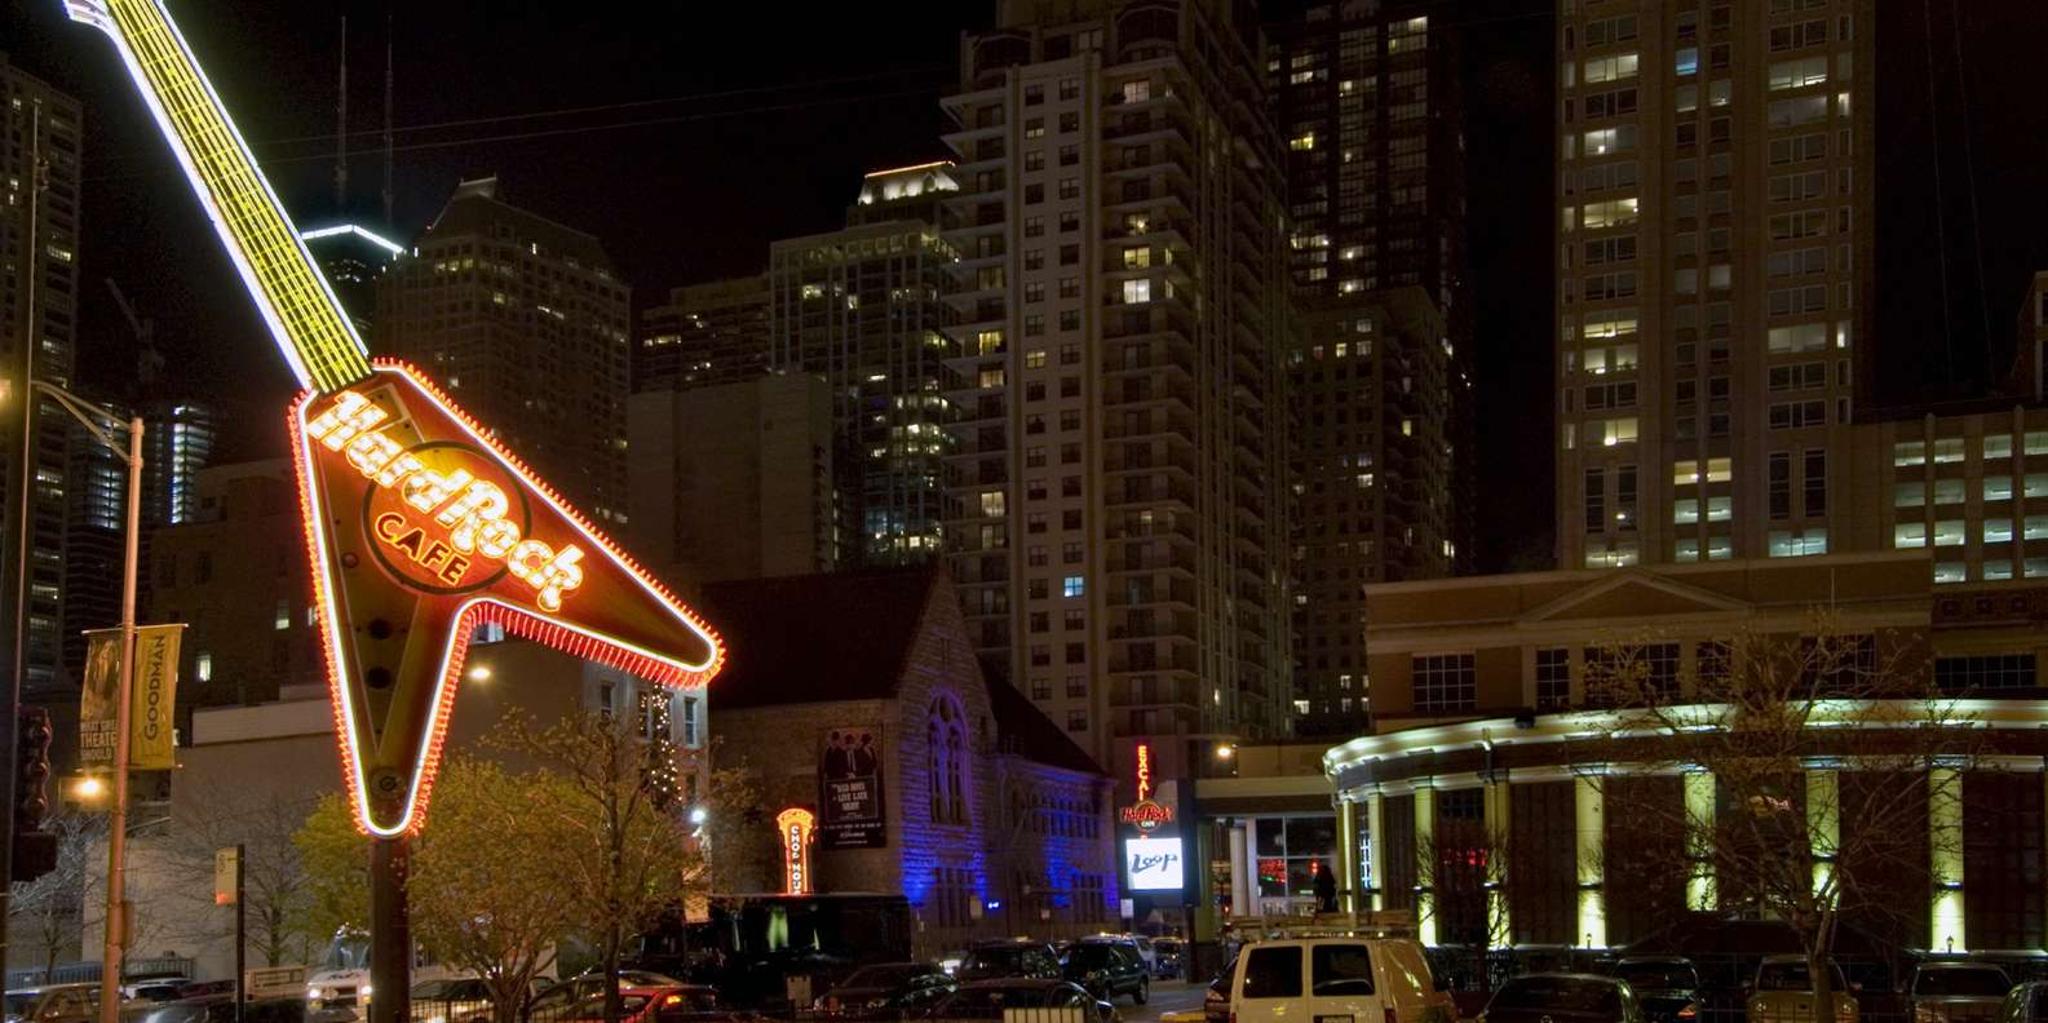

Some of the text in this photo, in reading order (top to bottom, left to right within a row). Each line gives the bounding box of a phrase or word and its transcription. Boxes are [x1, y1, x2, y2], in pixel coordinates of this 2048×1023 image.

[306, 390, 585, 613] Hard Rock
[375, 511, 472, 586] CAFE
[143, 634, 166, 741] GOODMAN
[1138, 745, 1149, 801] EXCAL
[791, 825, 800, 859] CHOP
[1131, 852, 1179, 874] Loop
